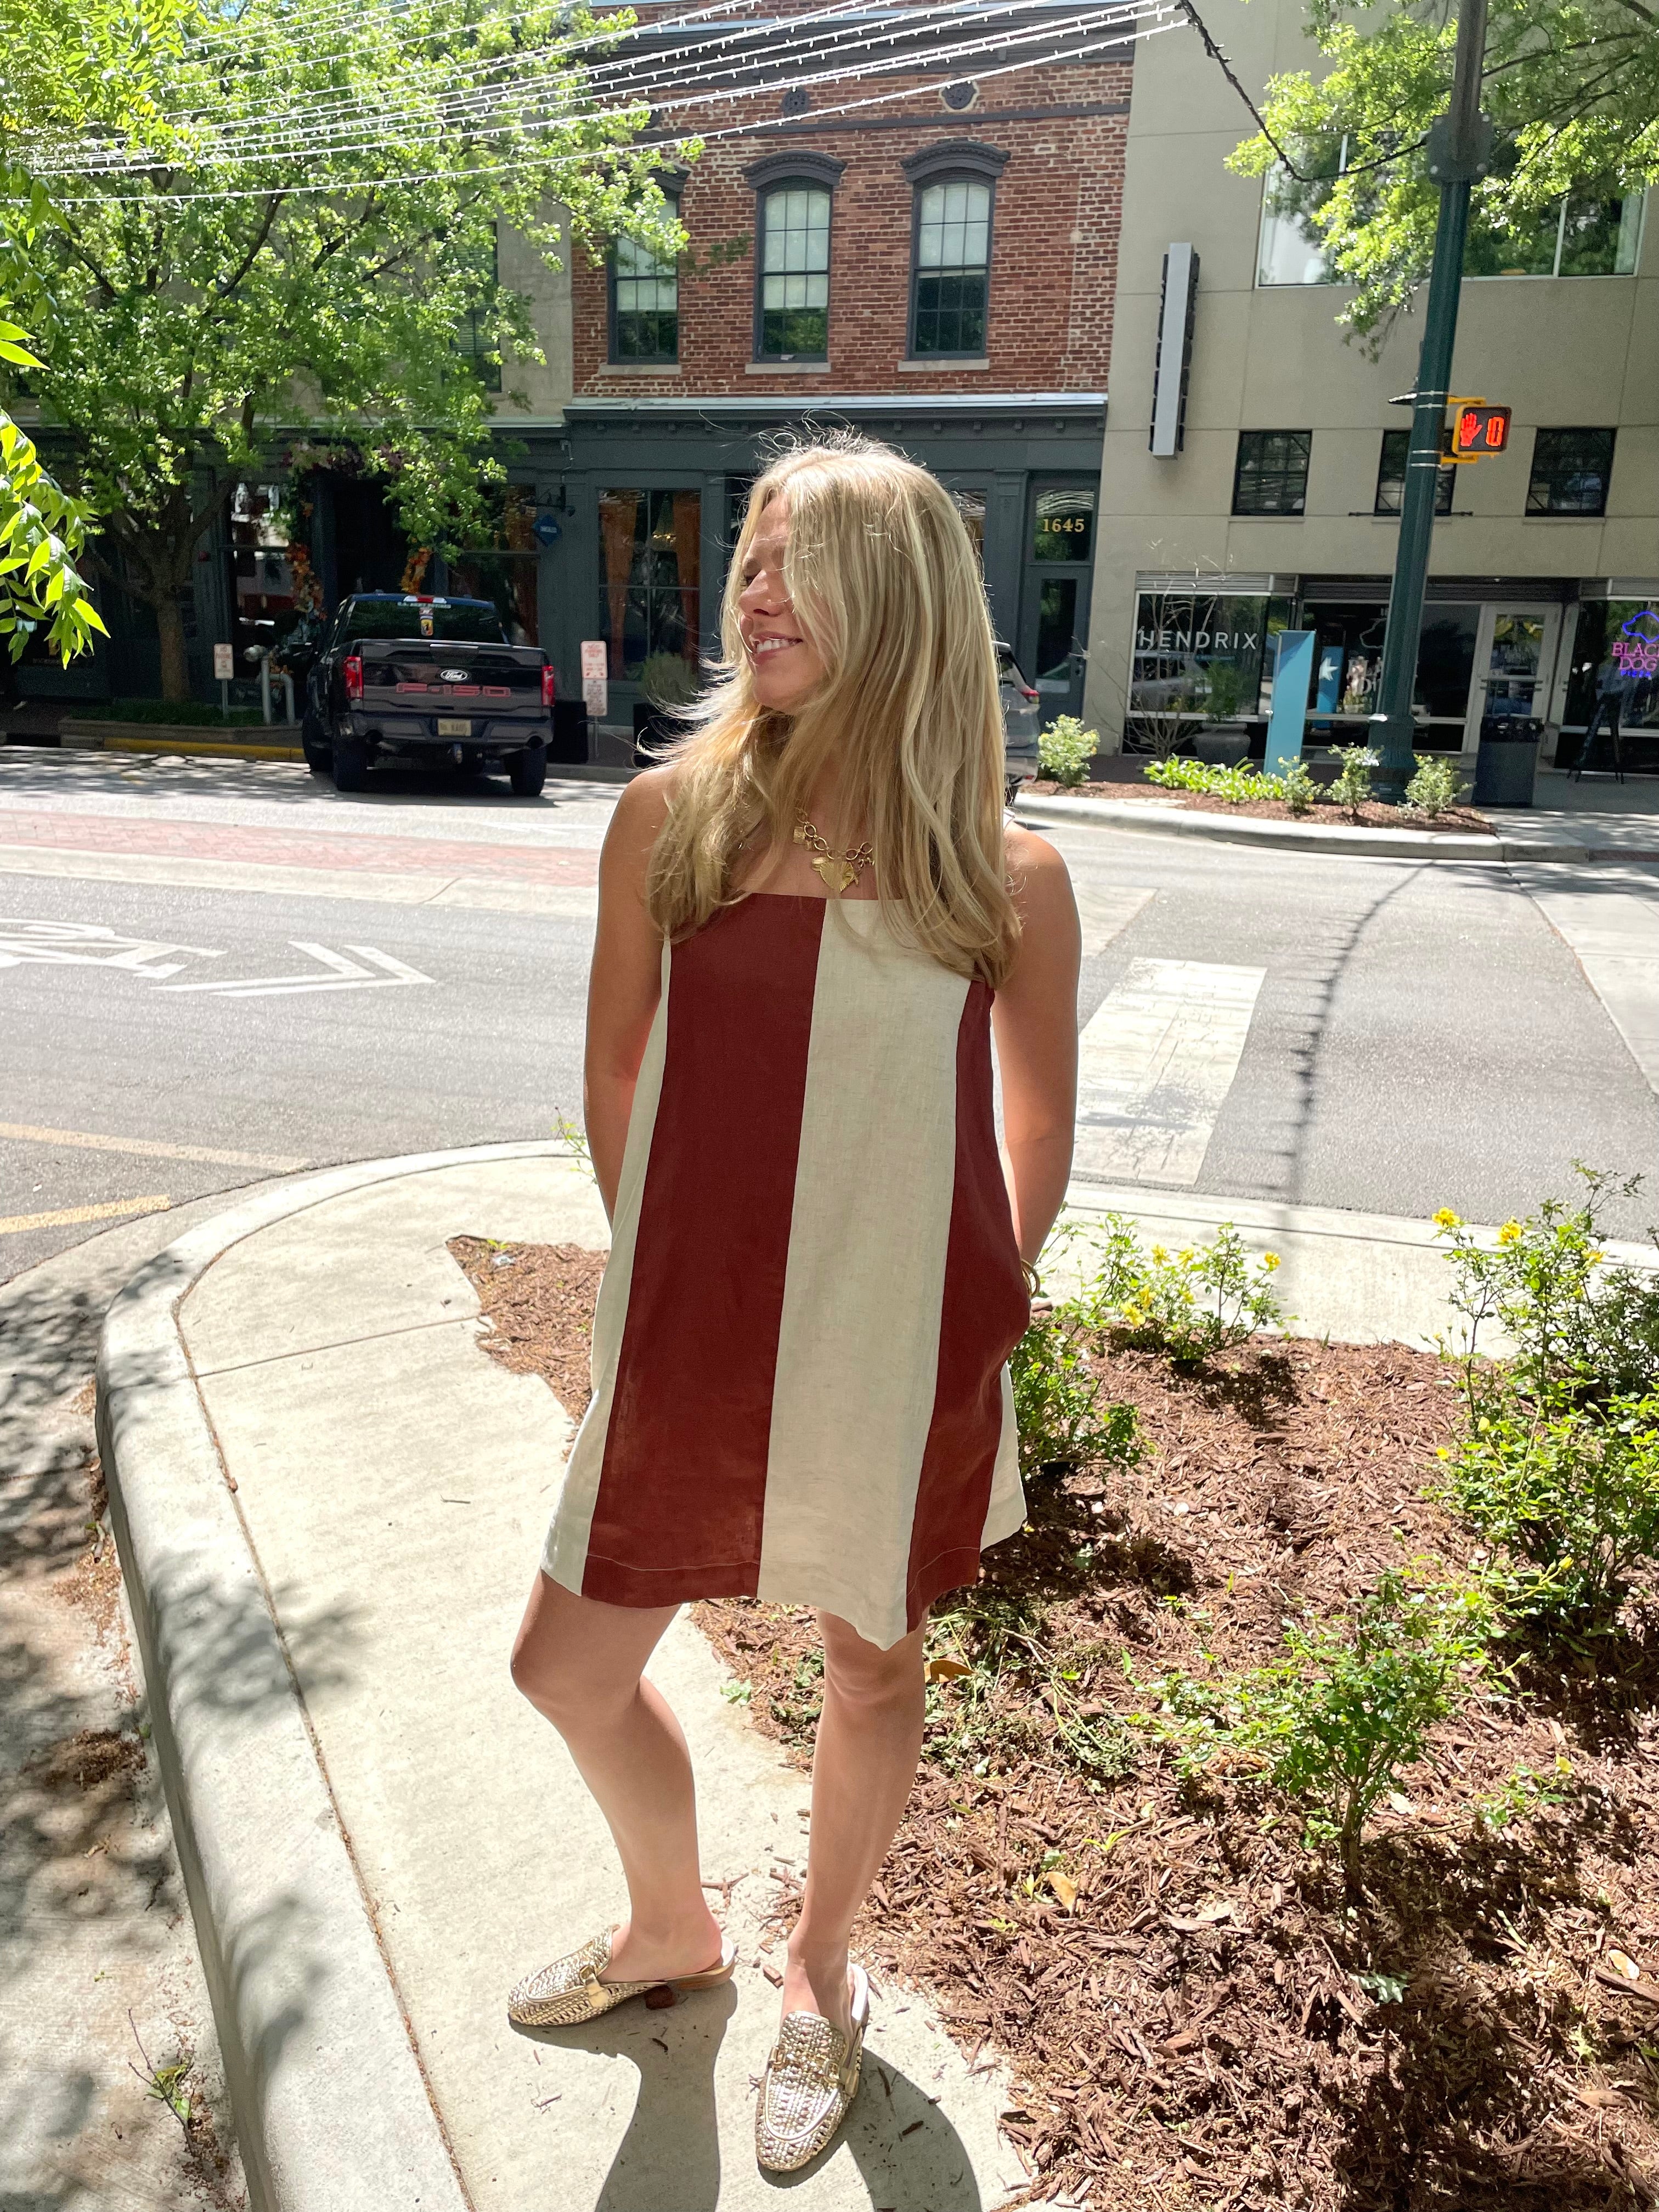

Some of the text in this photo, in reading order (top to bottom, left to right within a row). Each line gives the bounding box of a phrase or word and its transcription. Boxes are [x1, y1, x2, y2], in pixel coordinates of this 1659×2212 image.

[1486, 416, 1504, 447] 0
[1042, 518, 1085, 533] 1645
[1139, 630, 1257, 650] HENDRIX
[1618, 656, 1657, 672] DOG
[445, 671, 463, 680] Ford
[396, 682, 511, 697] F-150
